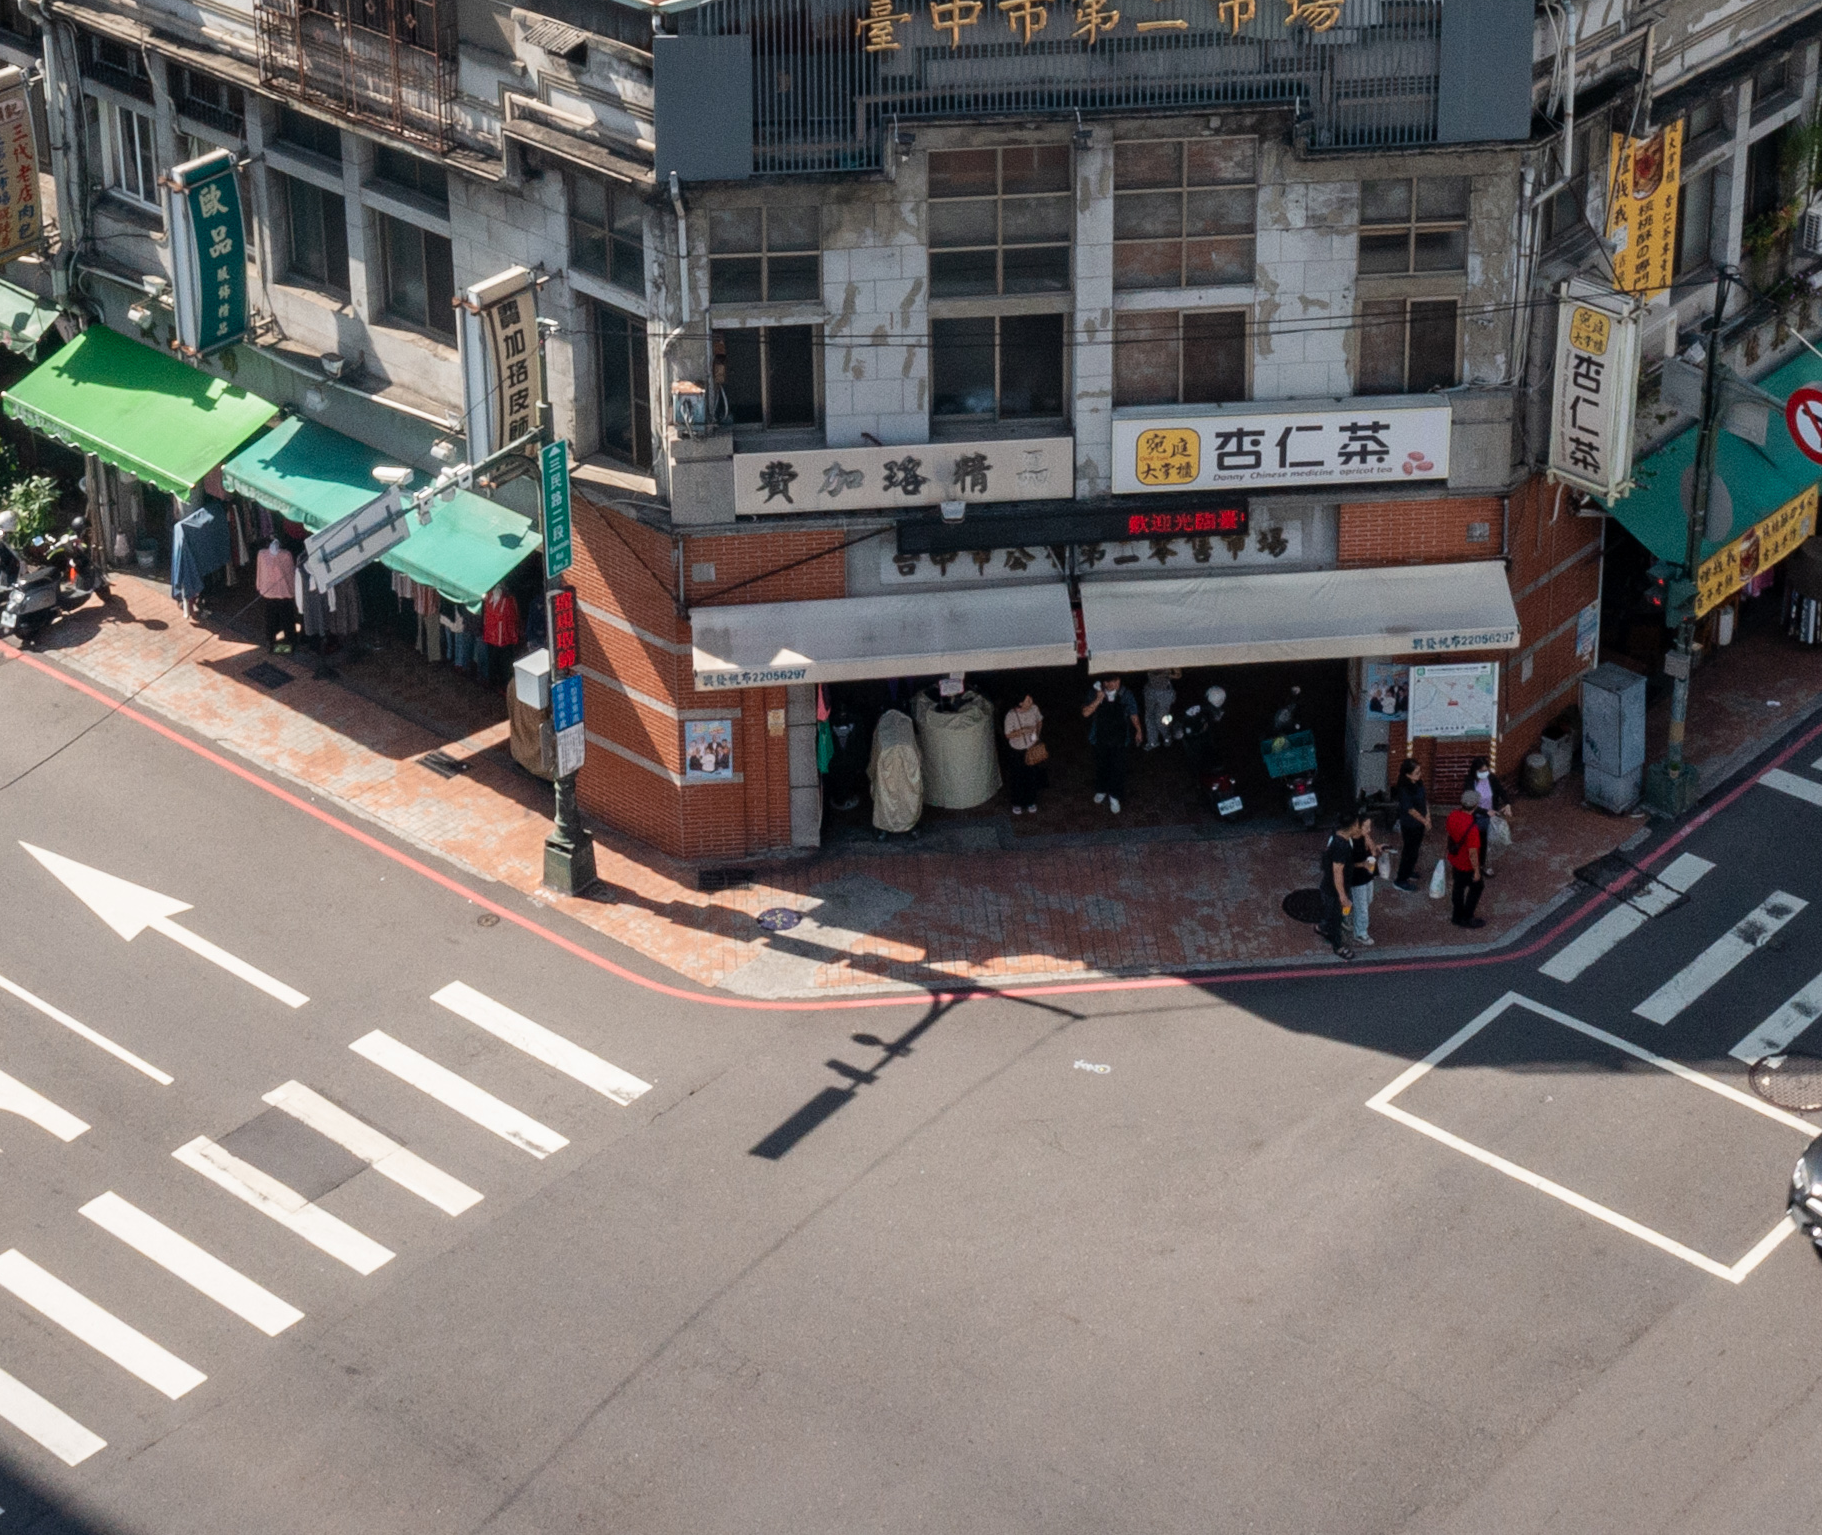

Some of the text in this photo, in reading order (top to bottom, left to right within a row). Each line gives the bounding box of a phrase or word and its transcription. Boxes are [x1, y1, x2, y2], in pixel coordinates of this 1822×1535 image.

[1568, 353, 1605, 474] 杏仁茶
[1213, 420, 1392, 472] 杏仁茶
[548, 457, 565, 542] 三民路二段
[1250, 470, 1288, 480] Chinese
[1289, 468, 1335, 478] medicine
[1128, 509, 1246, 535] 歡迎光臨臺
